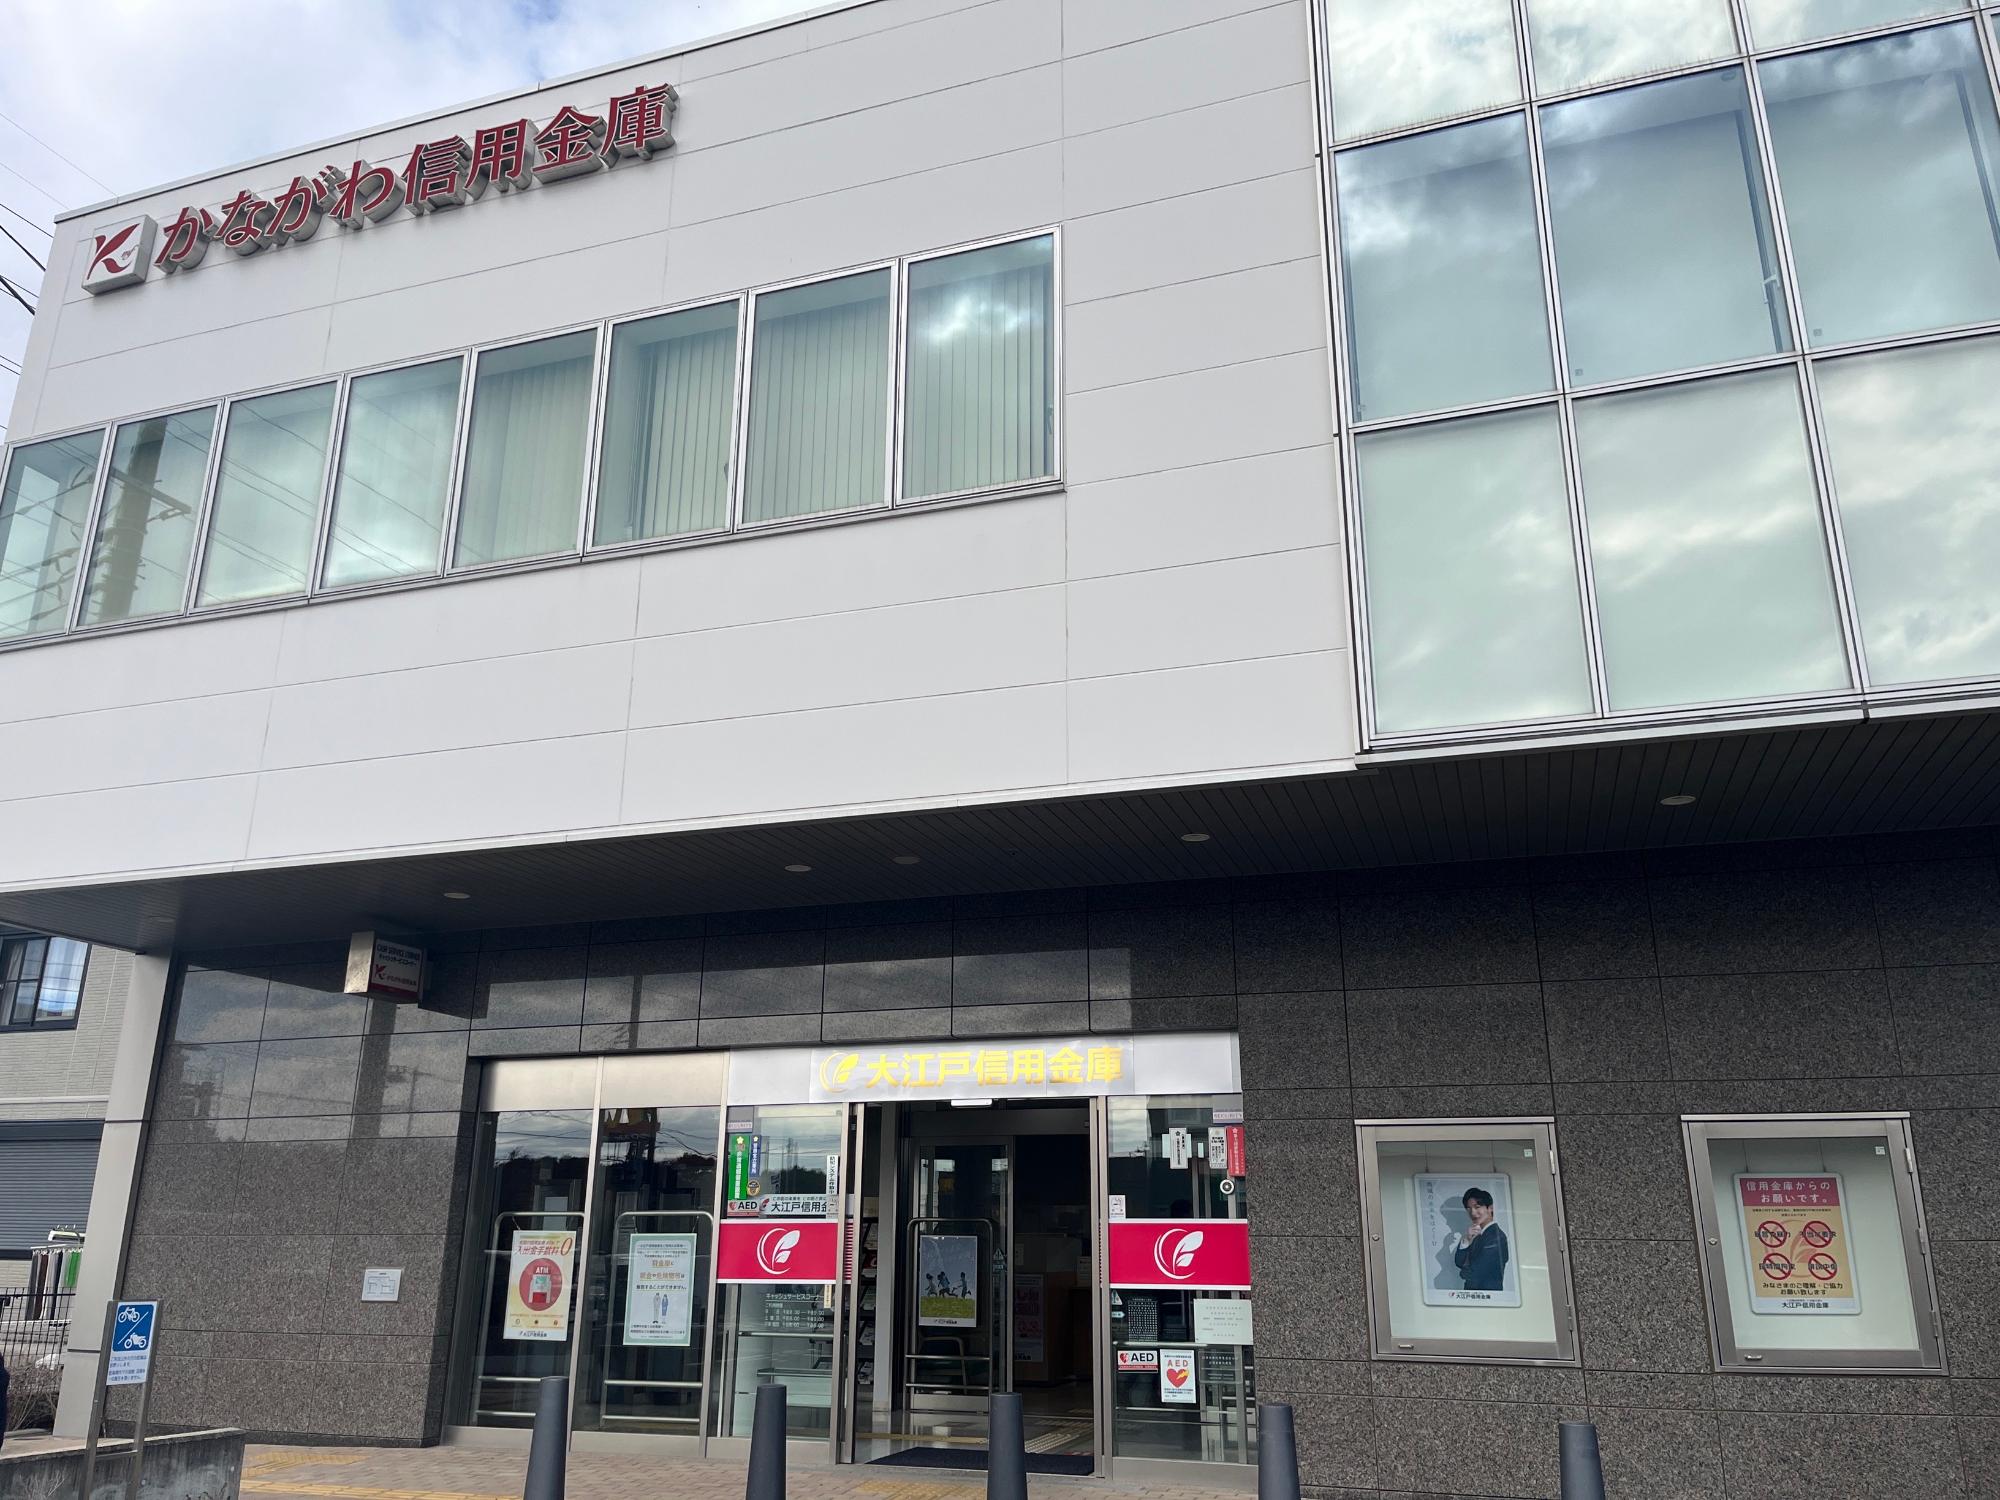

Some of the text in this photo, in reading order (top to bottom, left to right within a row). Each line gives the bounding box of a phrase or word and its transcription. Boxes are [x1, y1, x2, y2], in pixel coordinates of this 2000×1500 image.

[154, 82, 673, 266] かながわ信用金庫
[865, 1046, 1123, 1088] 大江戸信用金庫
[1746, 1181, 1831, 1191] 信用金庫からの
[1761, 1193, 1828, 1203] お願いです。
[738, 1202, 757, 1210] AED
[1131, 1353, 1154, 1361] AED
[1167, 1359, 1189, 1367] AED
